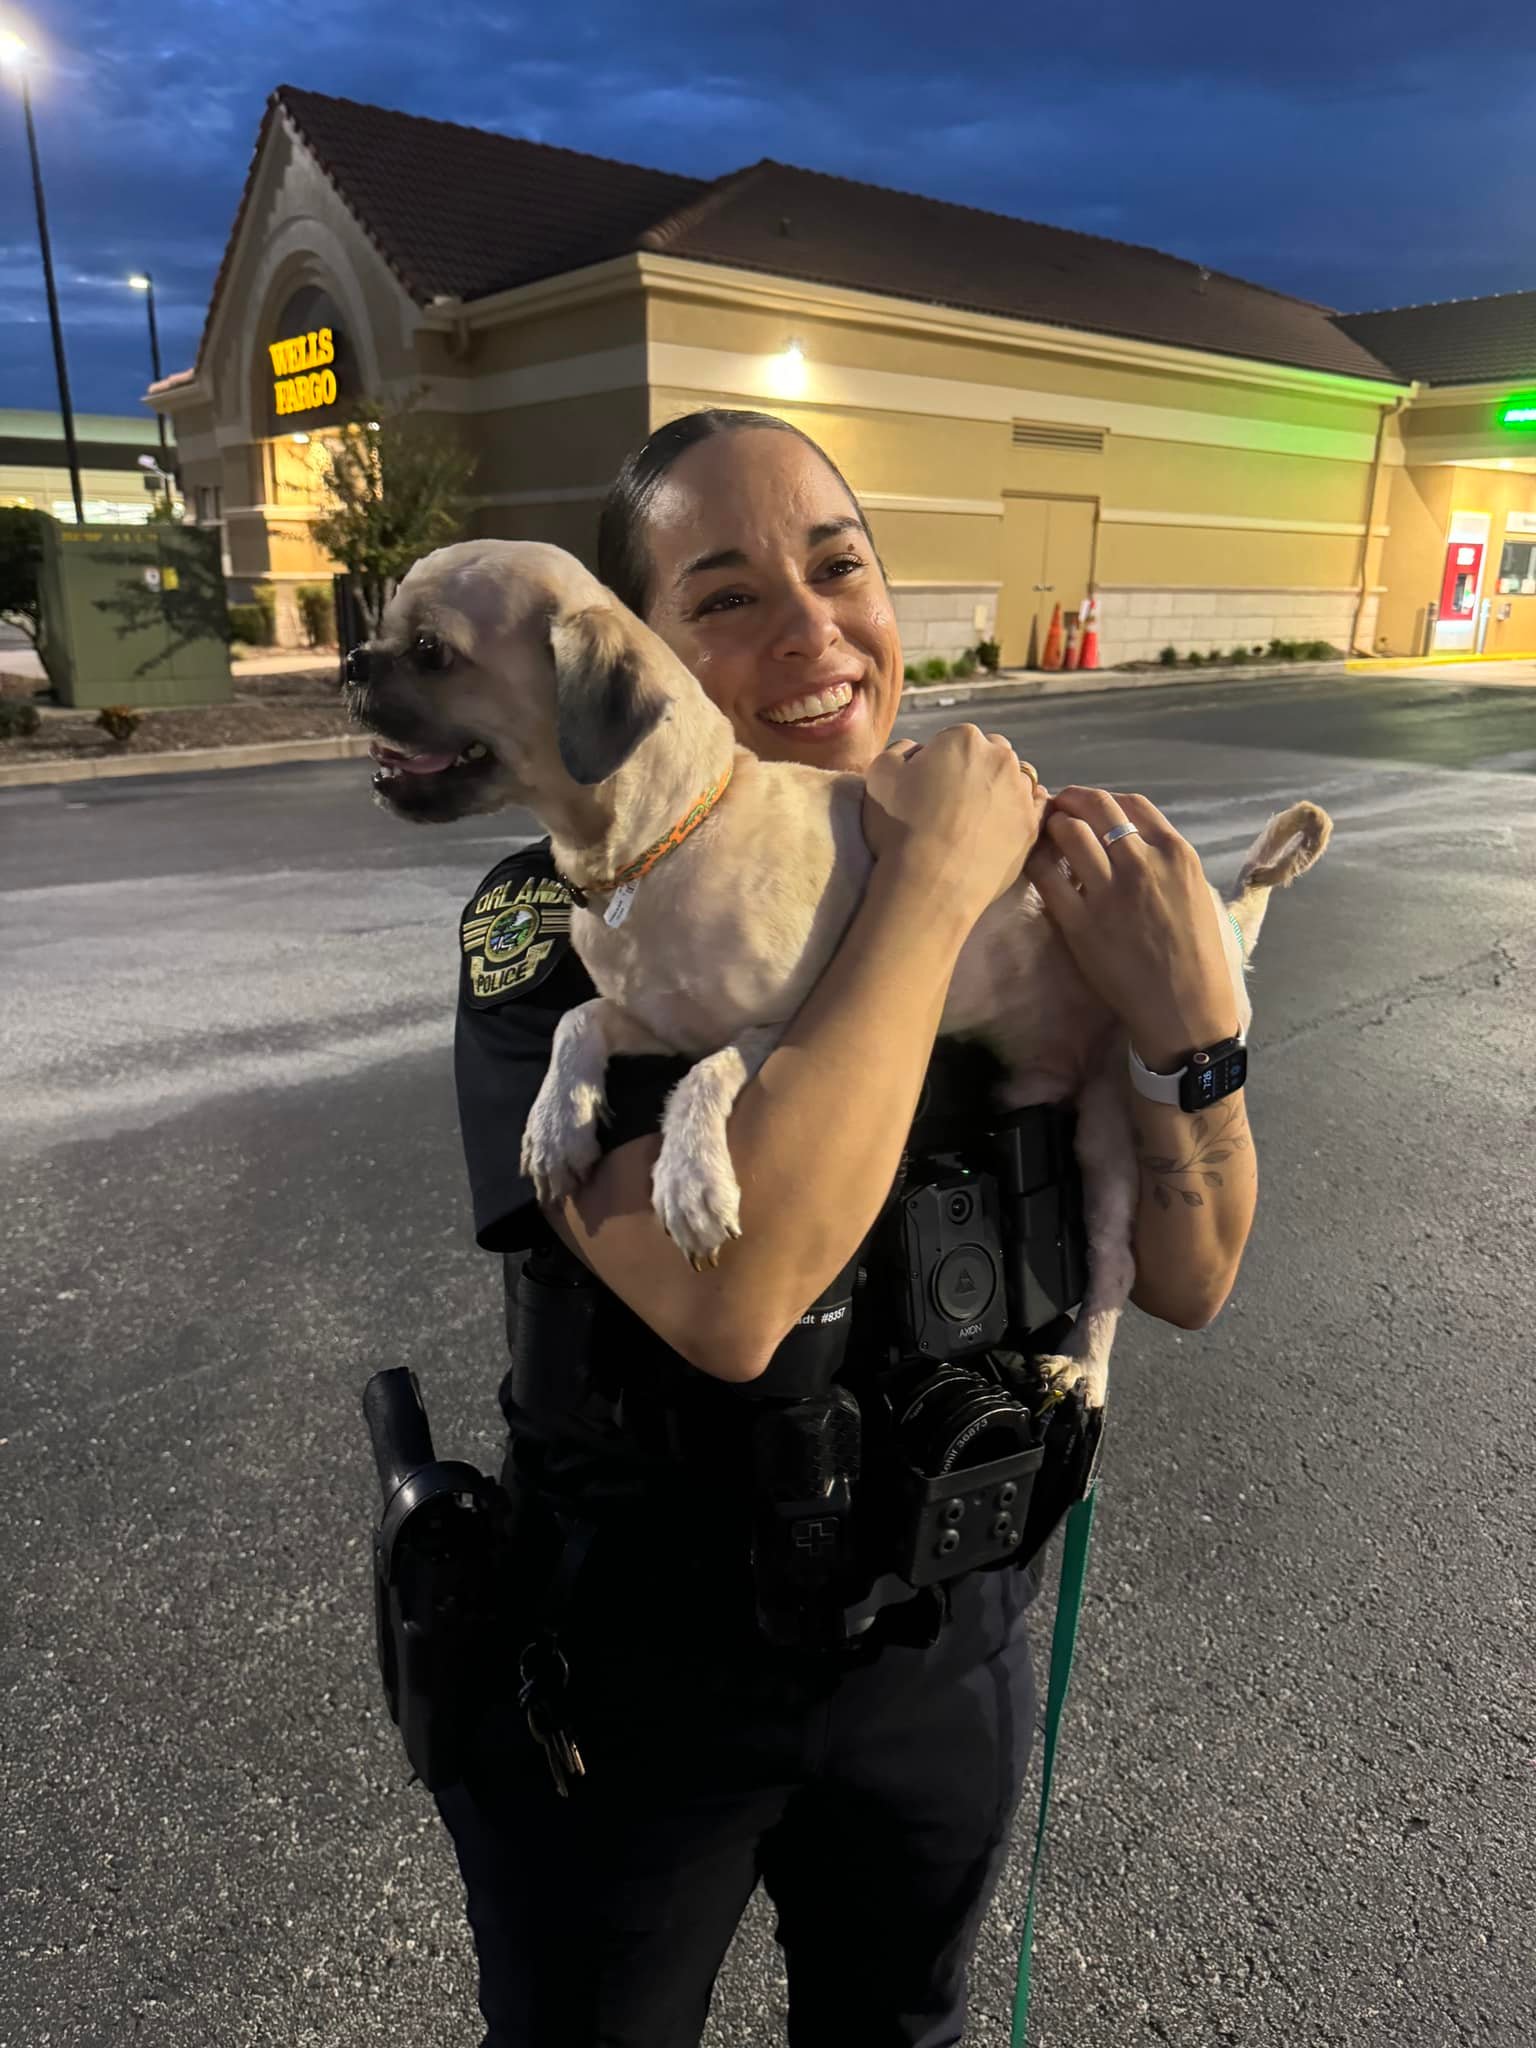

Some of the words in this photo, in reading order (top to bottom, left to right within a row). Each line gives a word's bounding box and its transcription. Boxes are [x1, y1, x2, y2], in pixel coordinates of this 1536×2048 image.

[269, 327, 335, 376] WELLS
[274, 368, 337, 415] FARGO
[476, 963, 528, 994] POLICE
[959, 1322, 983, 1338] AXON
